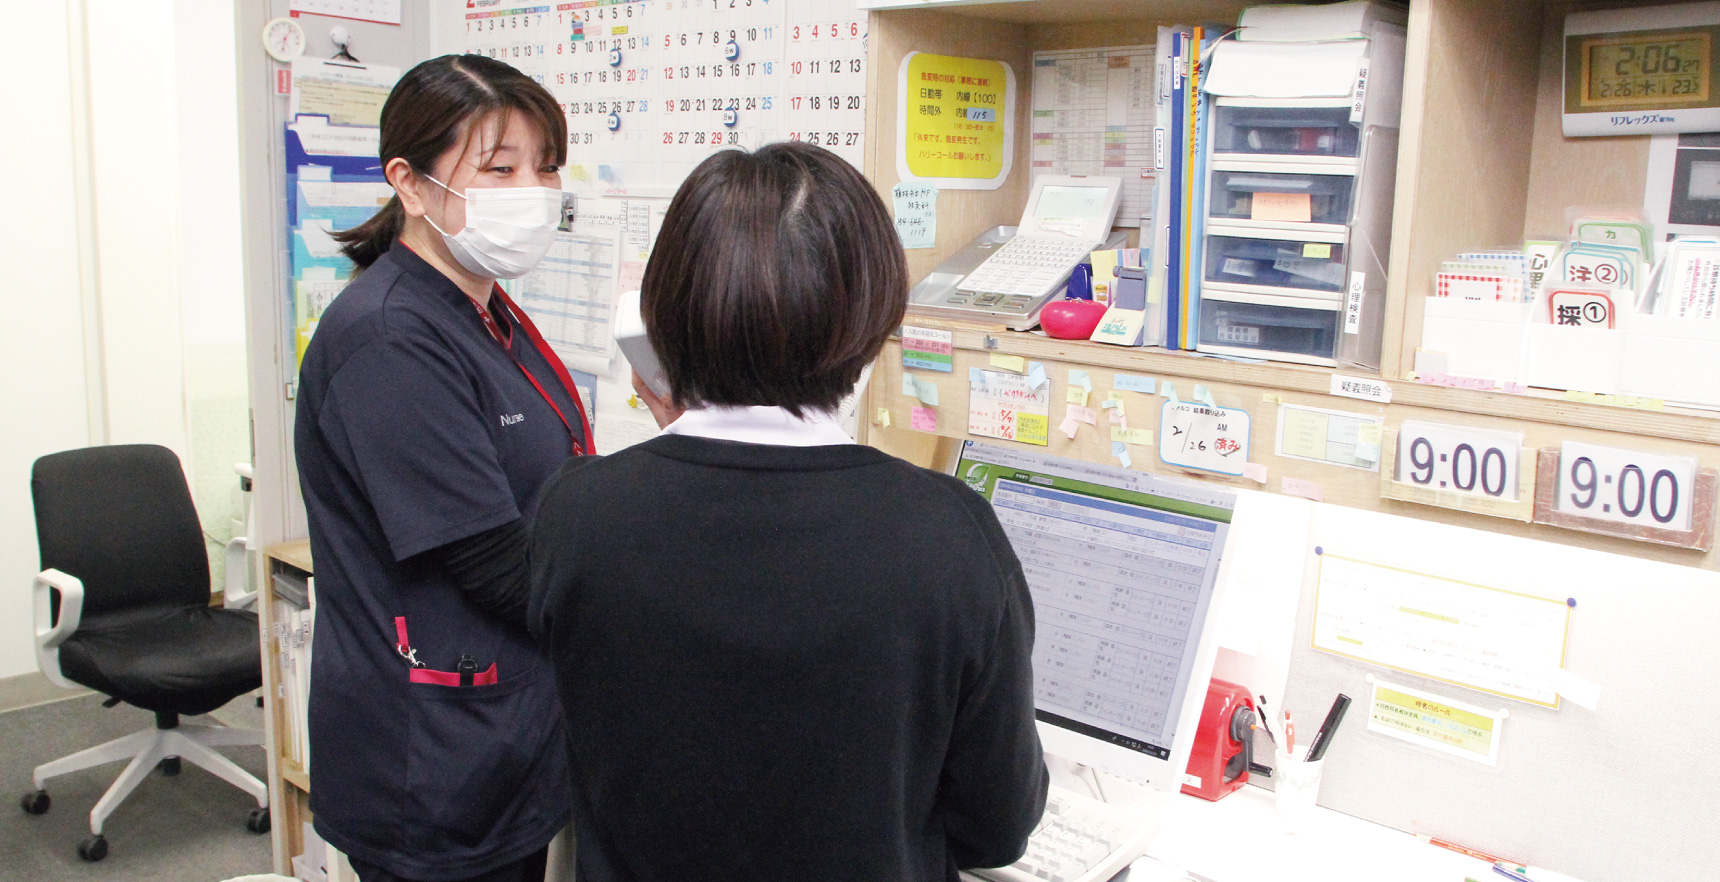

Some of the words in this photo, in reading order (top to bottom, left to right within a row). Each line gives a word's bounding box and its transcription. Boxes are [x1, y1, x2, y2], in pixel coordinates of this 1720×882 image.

[558, 13, 562, 24] 1
[585, 10, 589, 22] 3
[599, 9, 603, 20] 4
[613, 7, 617, 19] 5
[627, 6, 632, 17] 6
[641, 4, 645, 15] 7
[478, 20, 482, 31] 2
[490, 19, 494, 30] 3
[500, 17, 506, 28] 4
[511, 16, 516, 28] 5
[524, 16, 528, 27] 6
[537, 15, 541, 25] 7
[665, 35, 670, 47] 5
[681, 34, 686, 46] 6
[698, 32, 703, 44] 7
[714, 31, 719, 43] 8
[729, 30, 737, 43] 9
[747, 28, 756, 41] 10
[764, 27, 772, 39] 11
[793, 26, 799, 39] 3
[812, 25, 818, 38] 4
[831, 24, 837, 37] 5
[851, 23, 857, 36] 6
[501, 48, 507, 58] 11
[512, 46, 519, 57] 12
[524, 45, 531, 56] 13
[536, 45, 543, 55] 14
[557, 44, 562, 54] 8
[570, 42, 577, 53] 9
[584, 41, 593, 52] 10
[599, 40, 606, 51] 11
[612, 39, 621, 51] 12
[628, 37, 635, 49] 13
[641, 36, 649, 47] 14
[791, 61, 801, 74] 10
[810, 61, 819, 73] 11
[830, 60, 840, 73] 12
[850, 59, 860, 73] 13
[1616, 44, 1681, 76] 2:06
[557, 73, 564, 84] 15
[570, 72, 578, 83] 16
[584, 72, 592, 82] 17
[599, 71, 606, 82] 18
[613, 69, 621, 82] 19
[627, 69, 637, 81] 20
[640, 68, 648, 80] 21
[664, 67, 673, 79] 12
[680, 66, 689, 78] 13
[696, 66, 705, 77] 14
[713, 65, 722, 77] 15
[730, 63, 739, 76] 16
[747, 63, 756, 75] 17
[763, 62, 772, 75] 18
[920, 88, 942, 100] 日勤帯
[1601, 79, 1632, 97] 2/26
[571, 103, 579, 114] 23
[584, 102, 593, 113] 24
[598, 102, 606, 113] 25
[611, 101, 621, 114] 26
[627, 101, 635, 112] 27
[639, 100, 648, 112] 28
[665, 100, 674, 112] 19
[680, 99, 690, 111] 20
[696, 99, 705, 111] 21
[713, 99, 722, 110] 22
[728, 98, 739, 111] 23
[746, 97, 756, 110] 24
[761, 97, 772, 109] 25
[791, 97, 801, 109] 17
[809, 96, 820, 110] 18
[828, 96, 839, 109] 19
[848, 96, 859, 109] 20
[920, 104, 942, 116] 時間外
[972, 111, 988, 119] 115
[570, 133, 579, 144] 30
[584, 133, 592, 144] 31
[663, 132, 673, 144] 26
[679, 132, 689, 144] 27
[693, 132, 705, 144] 28
[711, 132, 722, 144] 29
[728, 132, 739, 145] 30
[807, 132, 819, 146] 25
[827, 132, 838, 145] 26
[846, 132, 859, 145] 27
[1348, 282, 1362, 324] 心理検査
[1340, 381, 1382, 397] 疑義照会
[1217, 423, 1228, 431] AM
[1216, 438, 1240, 452] 済み
[1410, 437, 1506, 496] 9:00
[1570, 456, 1678, 523] 9:00
